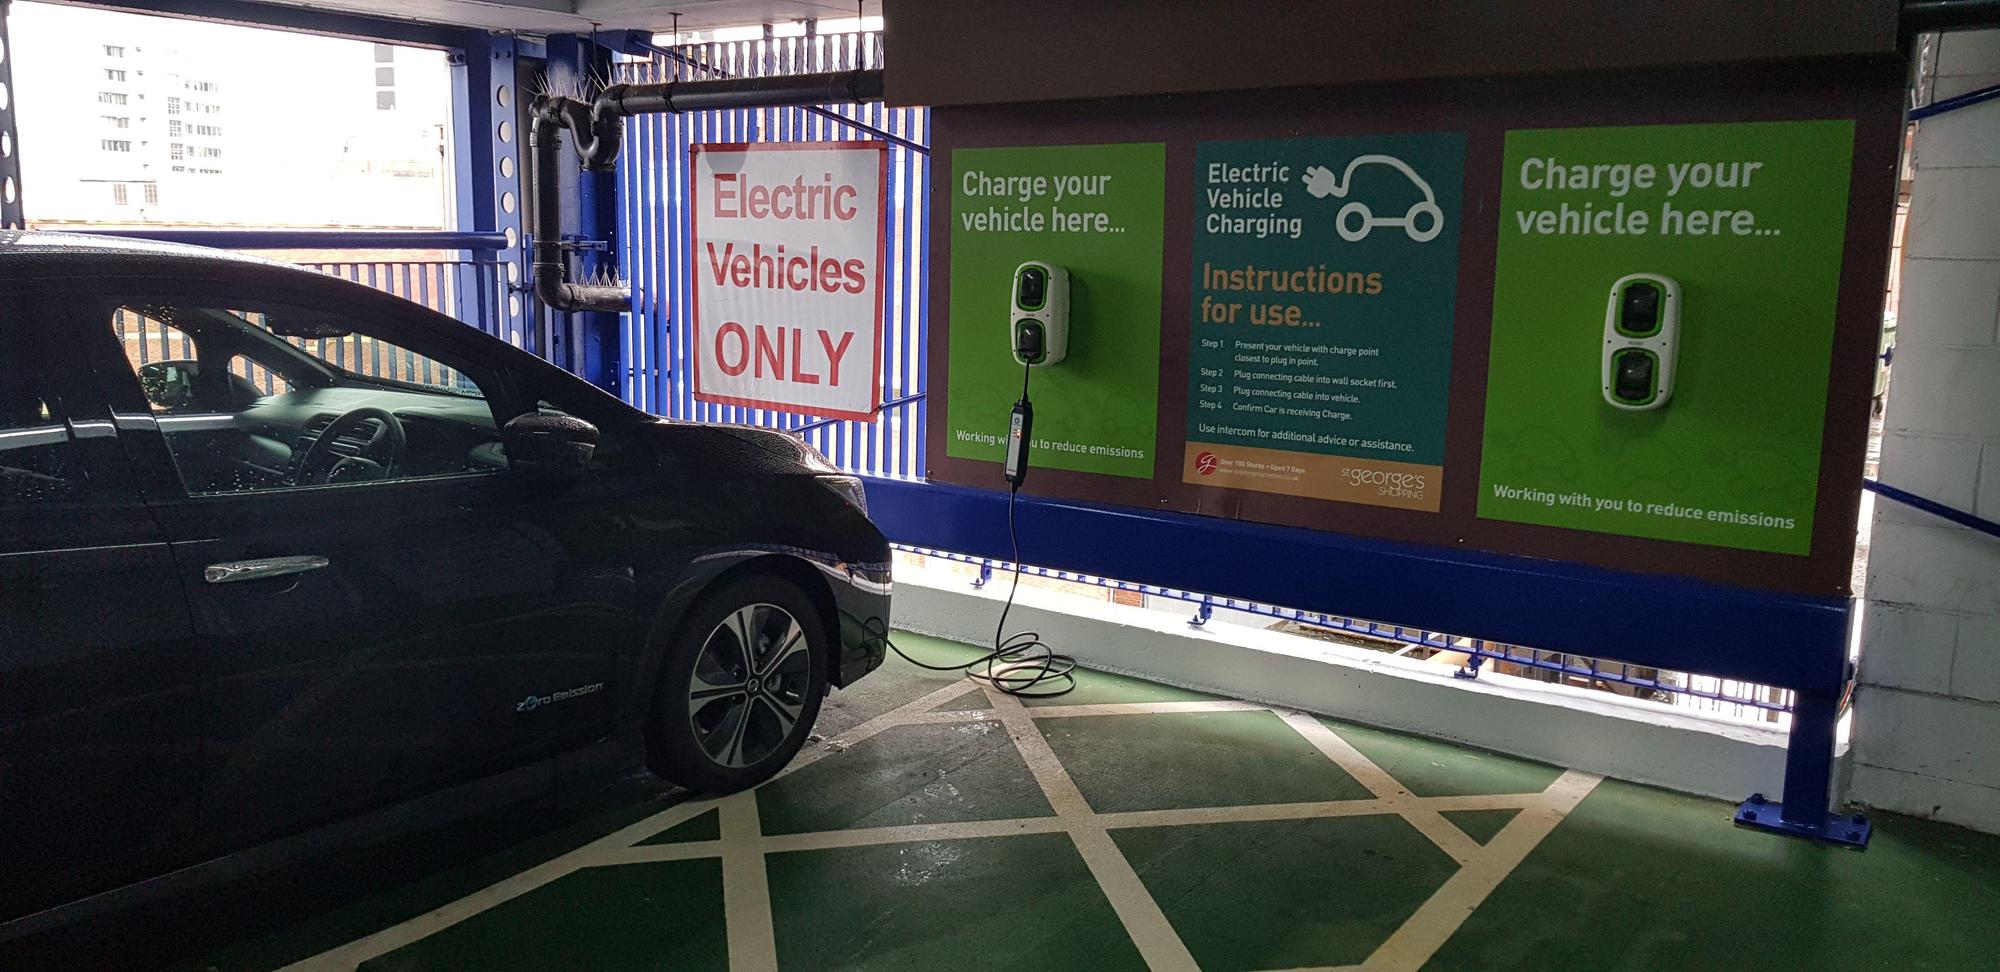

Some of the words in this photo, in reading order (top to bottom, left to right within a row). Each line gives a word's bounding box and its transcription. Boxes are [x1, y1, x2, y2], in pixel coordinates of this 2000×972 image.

[962, 171, 1047, 202] Charge
[1053, 175, 1112, 202] your
[1208, 162, 1290, 184] Electric
[1520, 157, 1656, 197] Charge
[1667, 161, 1764, 197] your
[714, 173, 857, 221] Electric
[1207, 188, 1283, 209] Vehicle
[961, 206, 1045, 232] vehicle
[1052, 206, 1125, 233] here...
[1206, 213, 1302, 239] Charging
[1516, 202, 1649, 235] vehicle
[1660, 202, 1781, 236] here...
[706, 241, 866, 294] Vehicles
[1203, 262, 1383, 295] Instructions
[1201, 296, 1242, 324] for
[1251, 304, 1321, 328] use...
[714, 321, 855, 387] ONLY
[1201, 339, 1219, 349] Step
[1220, 340, 1224, 348] 1
[1235, 340, 1264, 350] Present
[1265, 343, 1282, 352] your
[1283, 343, 1310, 352] vehicle
[1311, 344, 1328, 353] with
[1329, 346, 1357, 356] charge
[1358, 347, 1379, 357] point
[1234, 354, 1260, 363] closest
[1262, 355, 1269, 363] to
[1270, 356, 1288, 366] plug
[1289, 356, 1296, 364] in
[1297, 357, 1319, 367] point.
[1200, 368, 1217, 378] Step
[1218, 369, 1223, 377] 2
[1234, 370, 1251, 380] Plug
[1252, 371, 1293, 383] connecting
[1294, 374, 1314, 383] cable
[1315, 374, 1331, 384] into
[1332, 376, 1349, 385] wall
[1350, 378, 1376, 387] socket
[1378, 379, 1398, 388] first.
[1200, 384, 1217, 394] Step
[1218, 385, 1223, 393] 3
[1233, 386, 1251, 397] Plug
[1251, 389, 1292, 400] connecting
[1293, 391, 1314, 400] cable
[1314, 391, 1330, 401] into
[1331, 393, 1361, 404] vehicle.
[1199, 400, 1216, 410] Step
[1217, 400, 1222, 409] 4
[1232, 402, 1263, 412] Confirm
[1264, 404, 1277, 414] Car
[1279, 406, 1286, 414] is
[1286, 408, 1321, 419] receiving
[1322, 409, 1352, 421] Charge.
[956, 430, 996, 446] Working
[1040, 439, 1050, 449] to
[1051, 441, 1087, 453] reduce
[1089, 444, 1144, 459] emissions
[1199, 423, 1216, 433] Use
[1217, 424, 1256, 437] intercom
[1257, 428, 1270, 438] for
[1271, 430, 1316, 443] additional
[1317, 434, 1347, 445] advice
[1348, 439, 1360, 447] or
[1361, 439, 1415, 452] assistance.
[1291, 466, 1306, 474] Days
[1378, 486, 1424, 500] SHOPPING
[1493, 484, 1555, 506] Working
[1559, 492, 1592, 507] with
[1595, 497, 1623, 512] you
[1627, 498, 1643, 513] to
[1647, 502, 1703, 519] reduce
[1707, 508, 1796, 529] emissions
